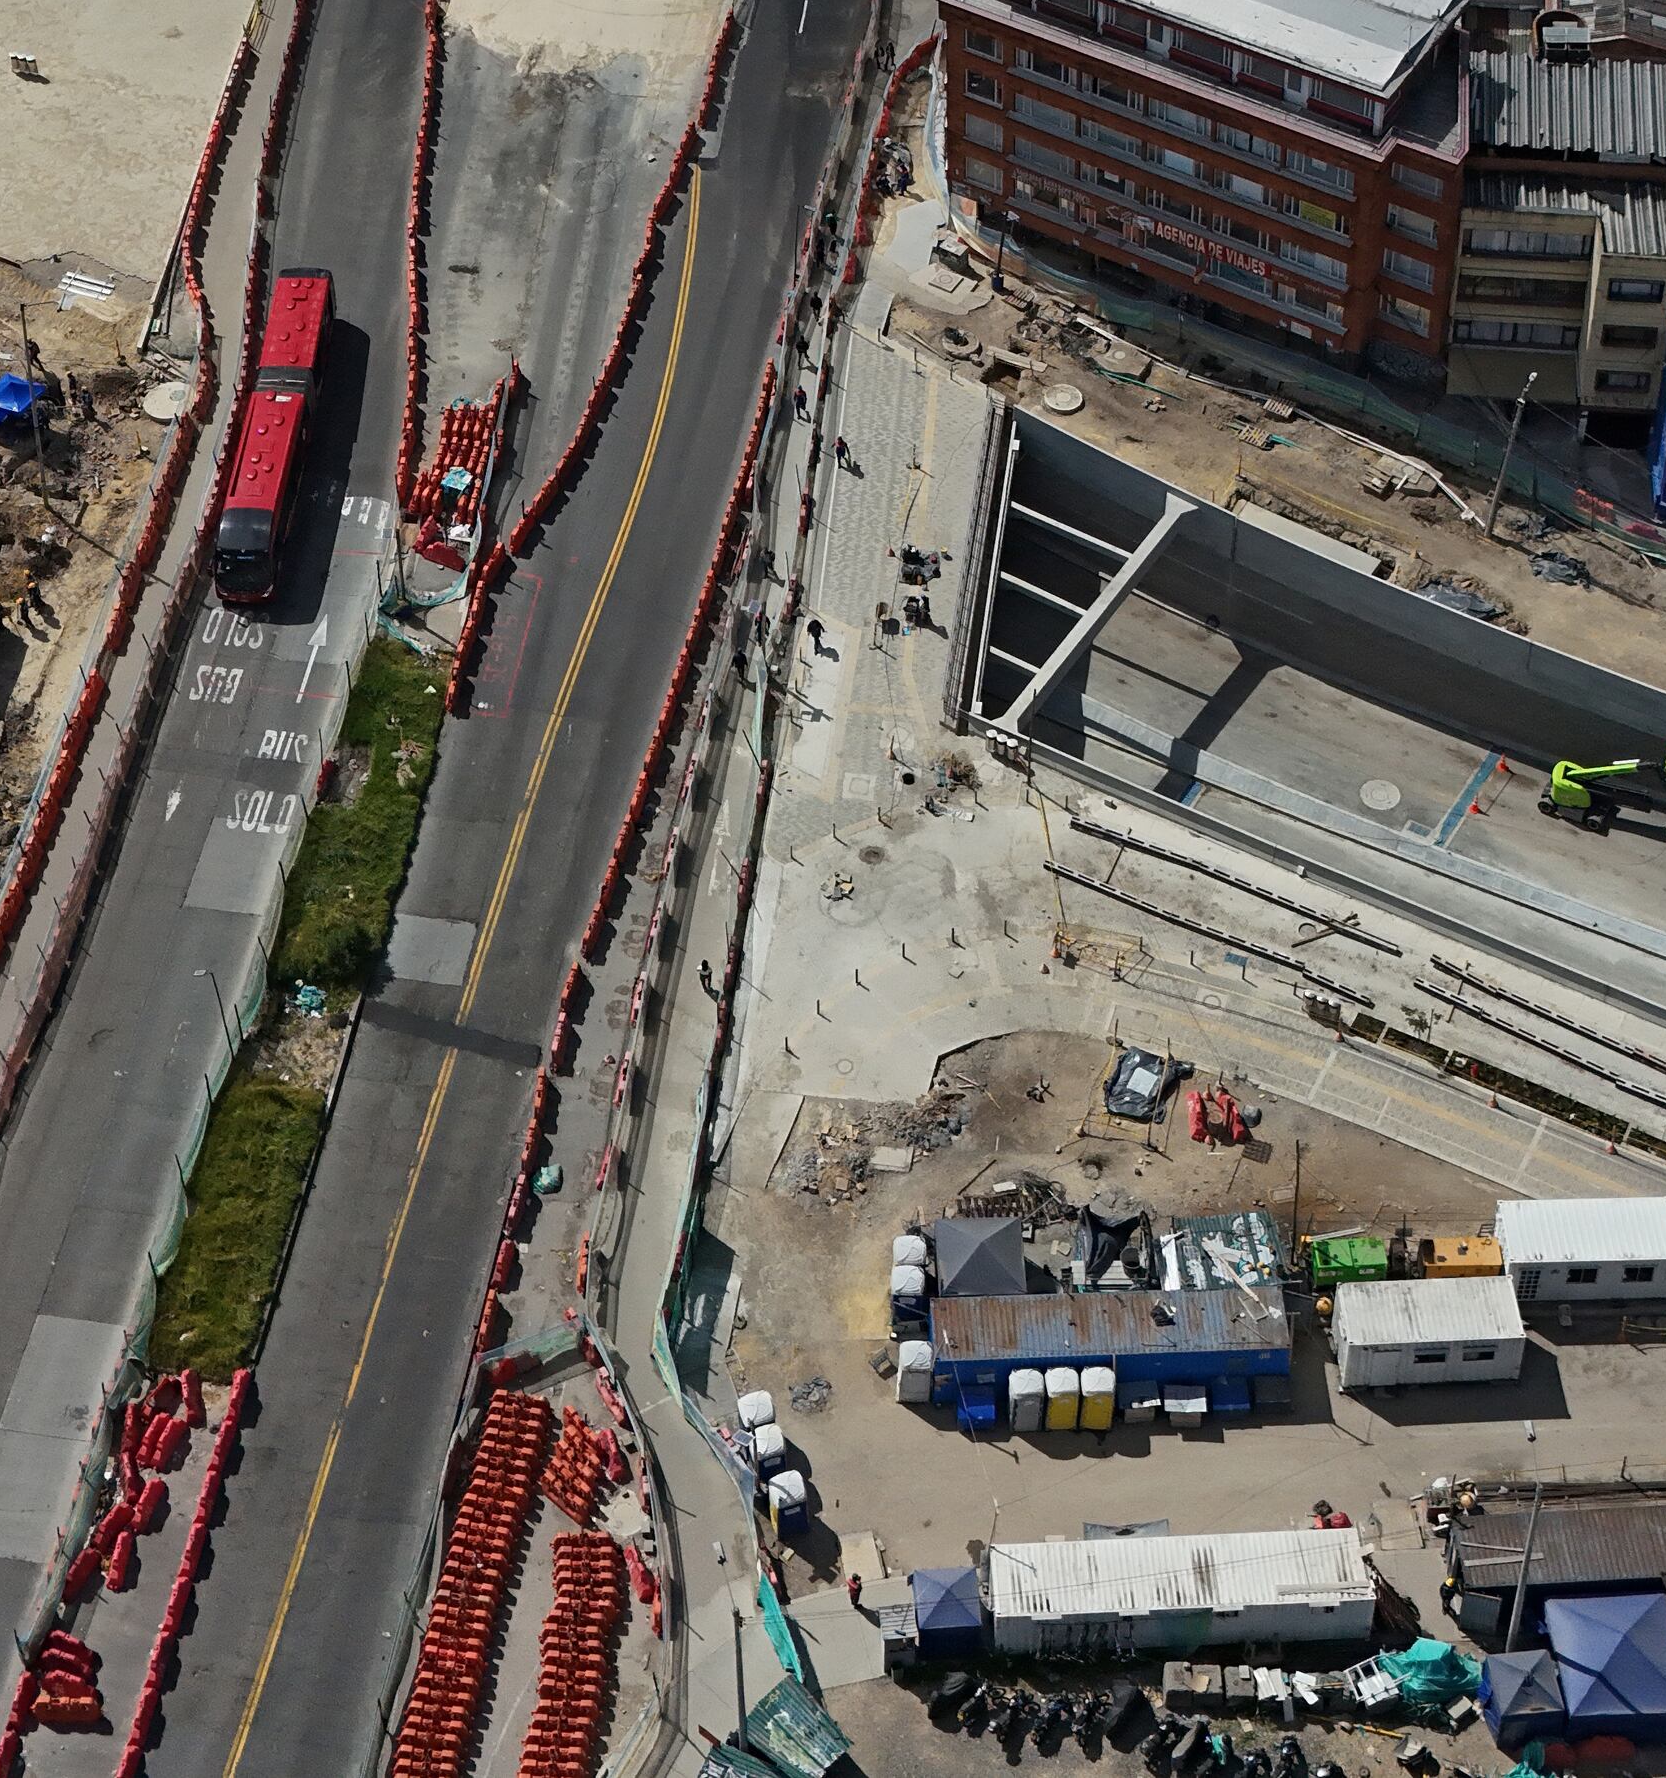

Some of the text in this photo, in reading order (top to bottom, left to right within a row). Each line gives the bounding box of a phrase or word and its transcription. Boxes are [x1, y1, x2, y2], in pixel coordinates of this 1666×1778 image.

[1155, 221, 1267, 277] AGENCIA DE VIAJES
[189, 664, 244, 705] BUS
[226, 789, 297, 835] SOLO
